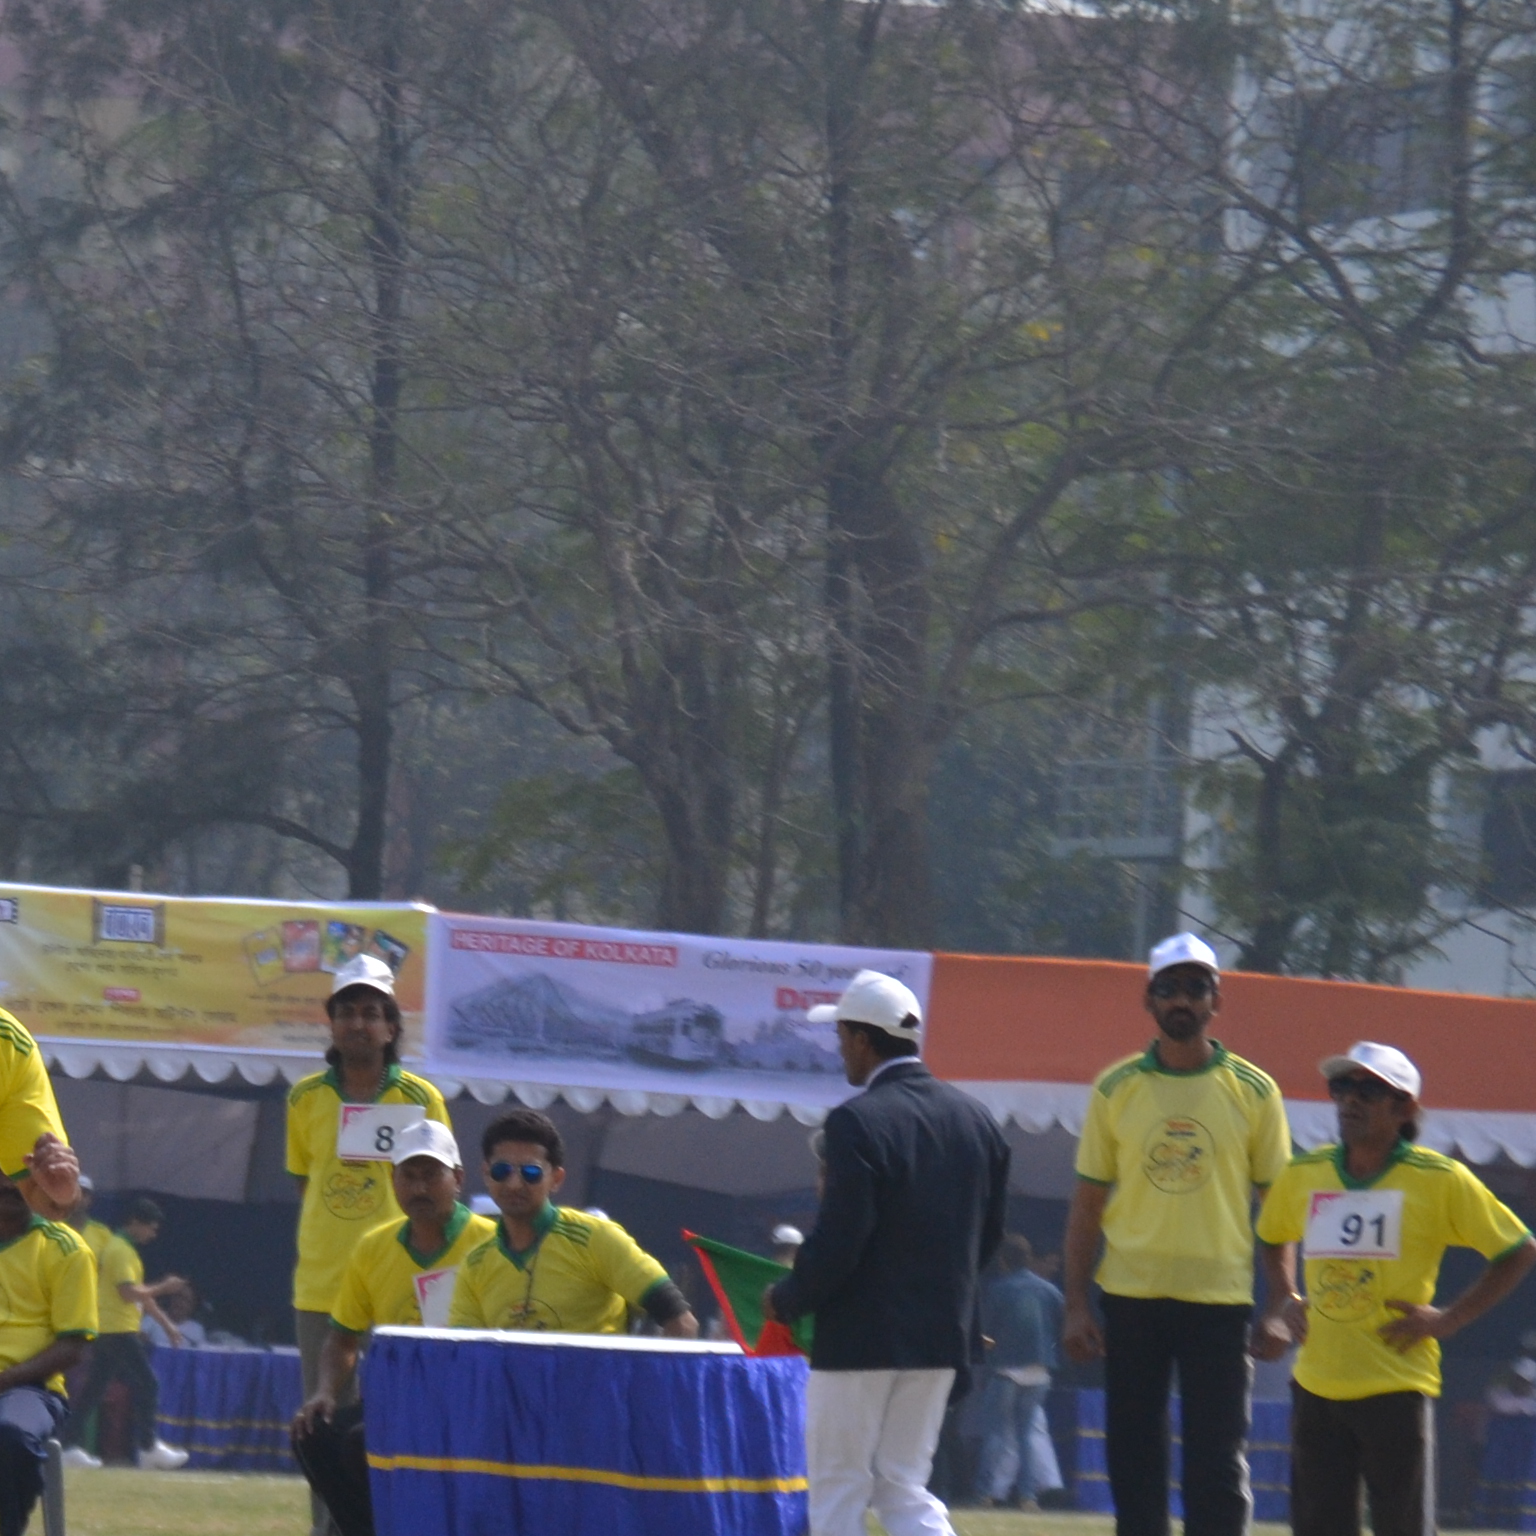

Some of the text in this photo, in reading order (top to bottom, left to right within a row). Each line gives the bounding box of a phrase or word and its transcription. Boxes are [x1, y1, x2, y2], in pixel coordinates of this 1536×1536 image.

[453, 931, 675, 966] HERITAGE OF KOLKATA
[1340, 1213, 1387, 1248] 91
